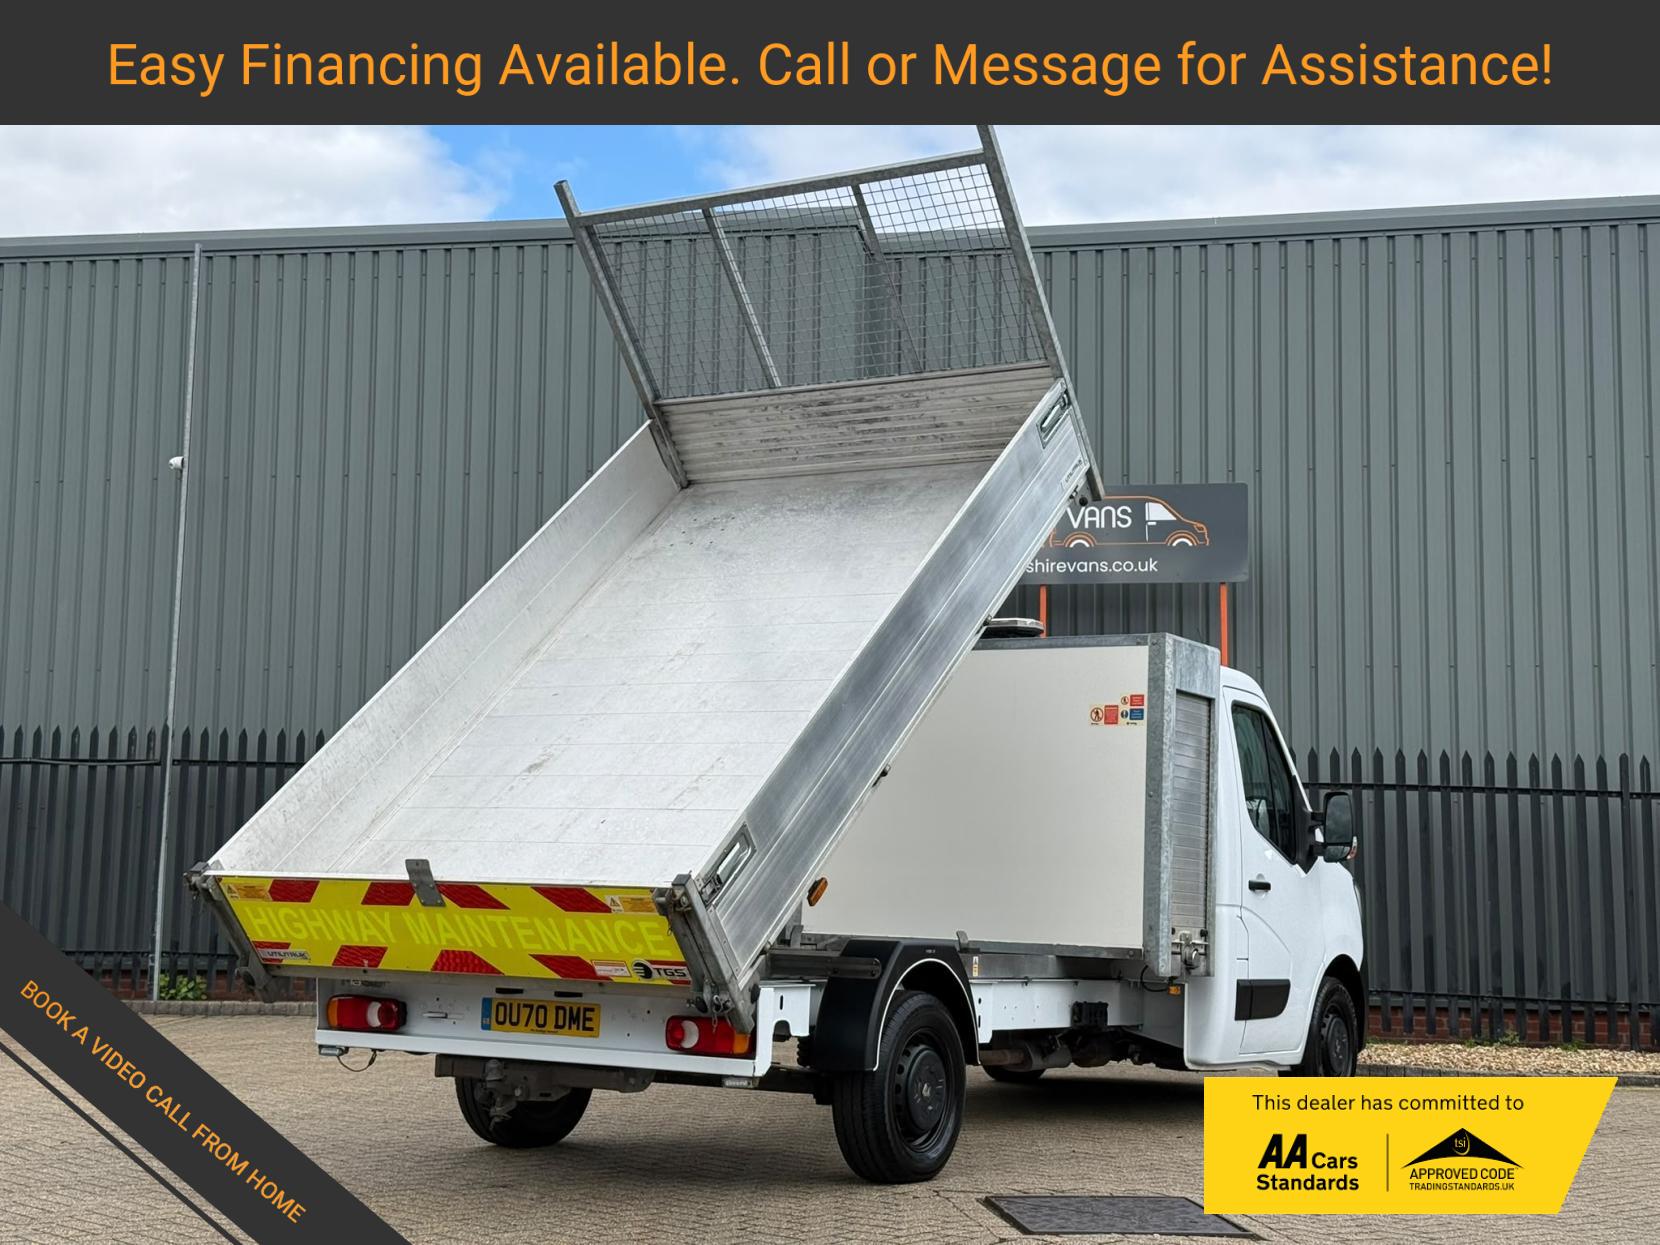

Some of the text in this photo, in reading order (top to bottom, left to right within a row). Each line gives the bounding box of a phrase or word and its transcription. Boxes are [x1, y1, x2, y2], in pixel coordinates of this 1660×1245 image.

[1066, 505, 1133, 530] VANS
[244, 906, 673, 957] HIGHWAY MAINTENANCE
[653, 967, 687, 978] TGS
[495, 1001, 596, 1032] OU70 DME
